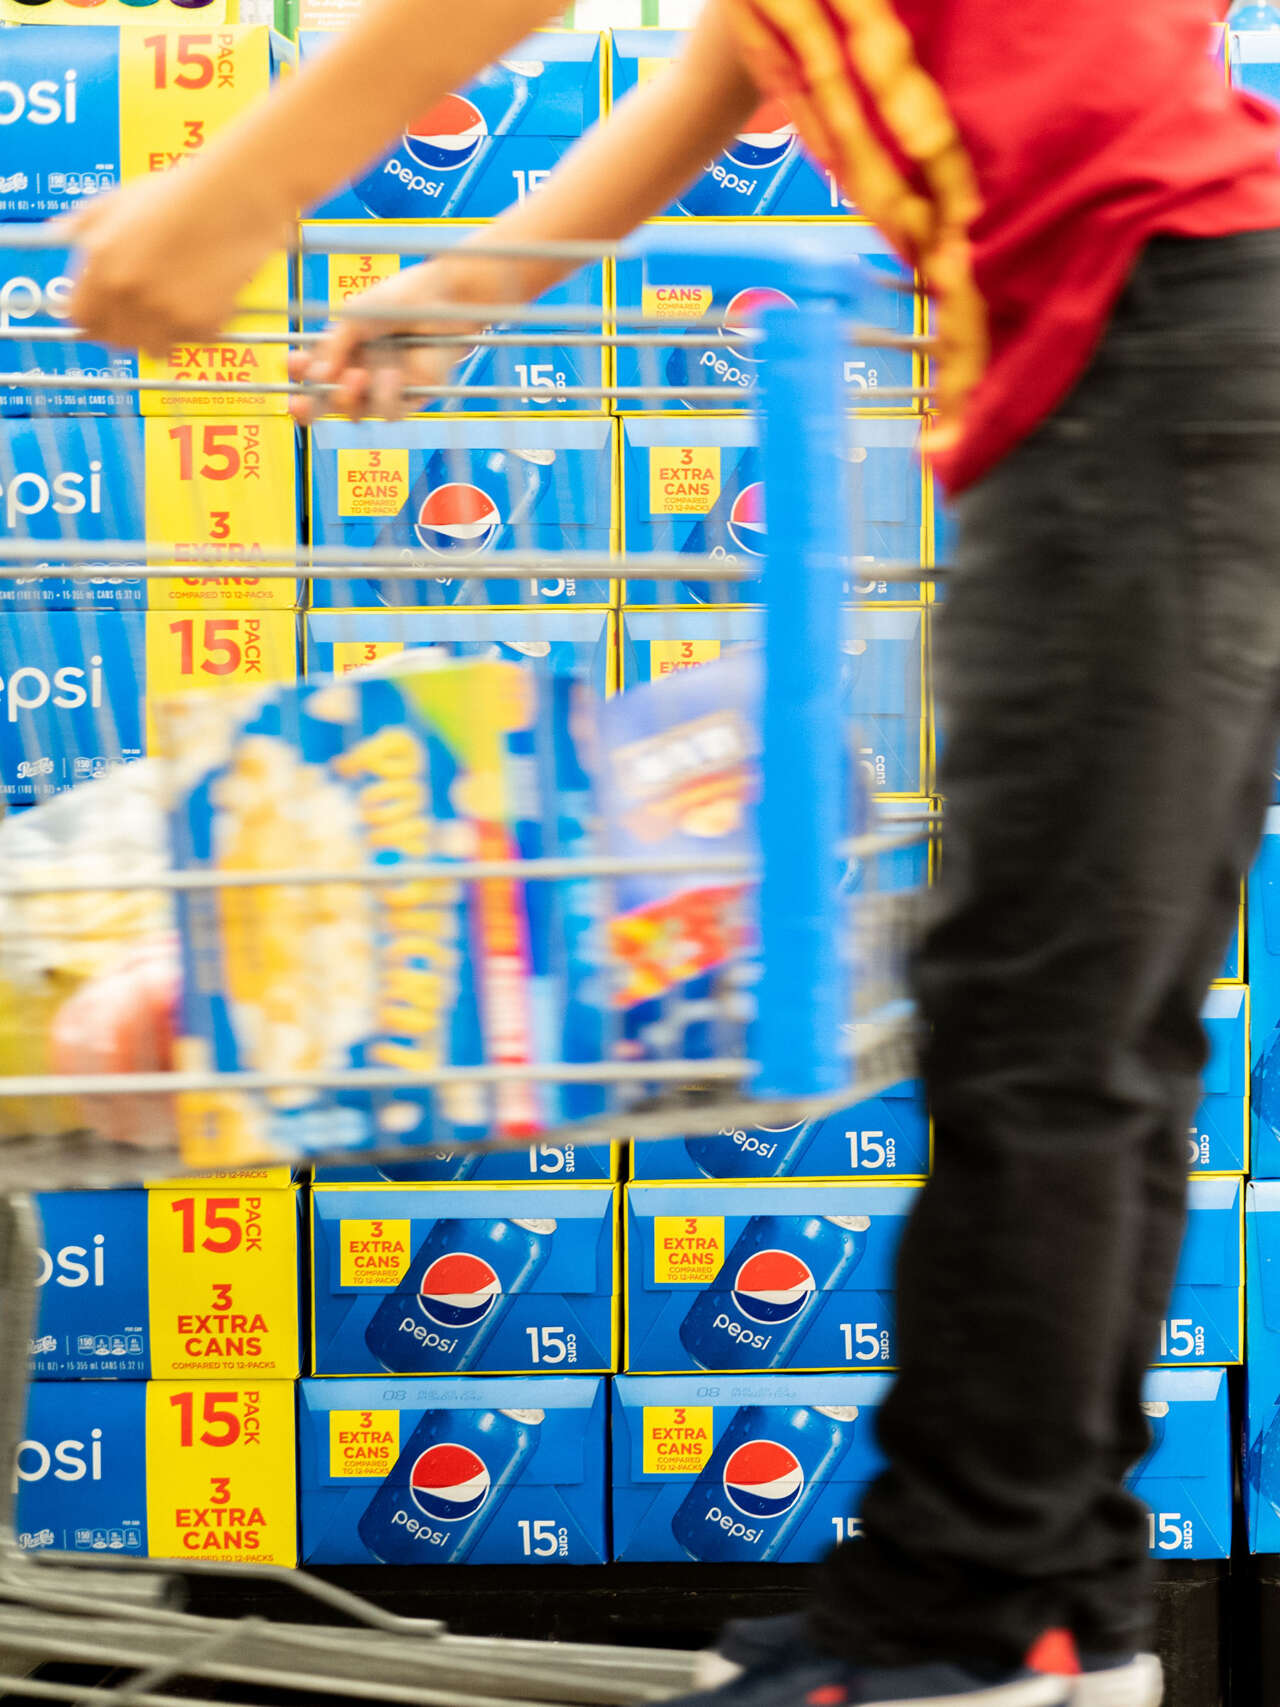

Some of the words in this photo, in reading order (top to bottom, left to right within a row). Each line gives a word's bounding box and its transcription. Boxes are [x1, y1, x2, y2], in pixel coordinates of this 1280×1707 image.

[146, 36, 214, 89] 15
[218, 35, 233, 88] PACK
[184, 122, 203, 148] 3
[384, 159, 444, 197] pepsi
[360, 256, 371, 272] 3
[657, 289, 701, 300] CANS
[168, 348, 257, 367] EXTRA
[169, 425, 240, 480] 15
[244, 425, 259, 478] PACK
[369, 452, 380, 467] 3
[681, 449, 692, 465] 3
[348, 471, 402, 482] EXTRA
[660, 468, 714, 480] EXTRA
[352, 486, 397, 497] CANS
[665, 484, 709, 495] CANS
[210, 512, 229, 538] 3
[170, 620, 241, 675] 15
[245, 620, 260, 672] PACK
[528, 1143, 564, 1173] 15
[846, 1131, 885, 1168] 15
[886, 1138, 895, 1167] cans
[1200, 1135, 1209, 1164] cans
[172, 1198, 242, 1253] 15
[246, 1198, 261, 1251] PACK
[371, 1222, 382, 1237] 3
[685, 1219, 696, 1234] 3
[350, 1241, 404, 1252] EXTRA
[664, 1238, 718, 1249] EXTRA
[355, 1256, 399, 1268] CANS
[669, 1253, 713, 1264] CANS
[212, 1284, 232, 1310] 3
[178, 1315, 268, 1333] EXTRA
[399, 1317, 458, 1353] pepsi
[713, 1312, 772, 1349] pepsi
[185, 1338, 261, 1356] CANS
[526, 1327, 566, 1363] 15
[567, 1334, 576, 1362] cans
[840, 1323, 879, 1360] 15
[880, 1331, 889, 1359] cans
[1195, 1326, 1204, 1355] cans
[170, 1392, 240, 1447] 15
[244, 1392, 259, 1444] PACK
[360, 1413, 372, 1428] 3
[674, 1409, 685, 1424] 3
[339, 1432, 393, 1443] EXTRA
[653, 1428, 706, 1439] EXTRA
[344, 1447, 389, 1458] CANS
[657, 1443, 702, 1454] CANS
[210, 1478, 230, 1504] 3
[176, 1508, 266, 1527] EXTRA
[392, 1508, 451, 1546] pepsi
[706, 1505, 764, 1543] pepsi
[184, 1531, 259, 1549] CANS
[518, 1521, 558, 1556] 15
[559, 1528, 568, 1556] cans
[1184, 1521, 1192, 1549] cans
